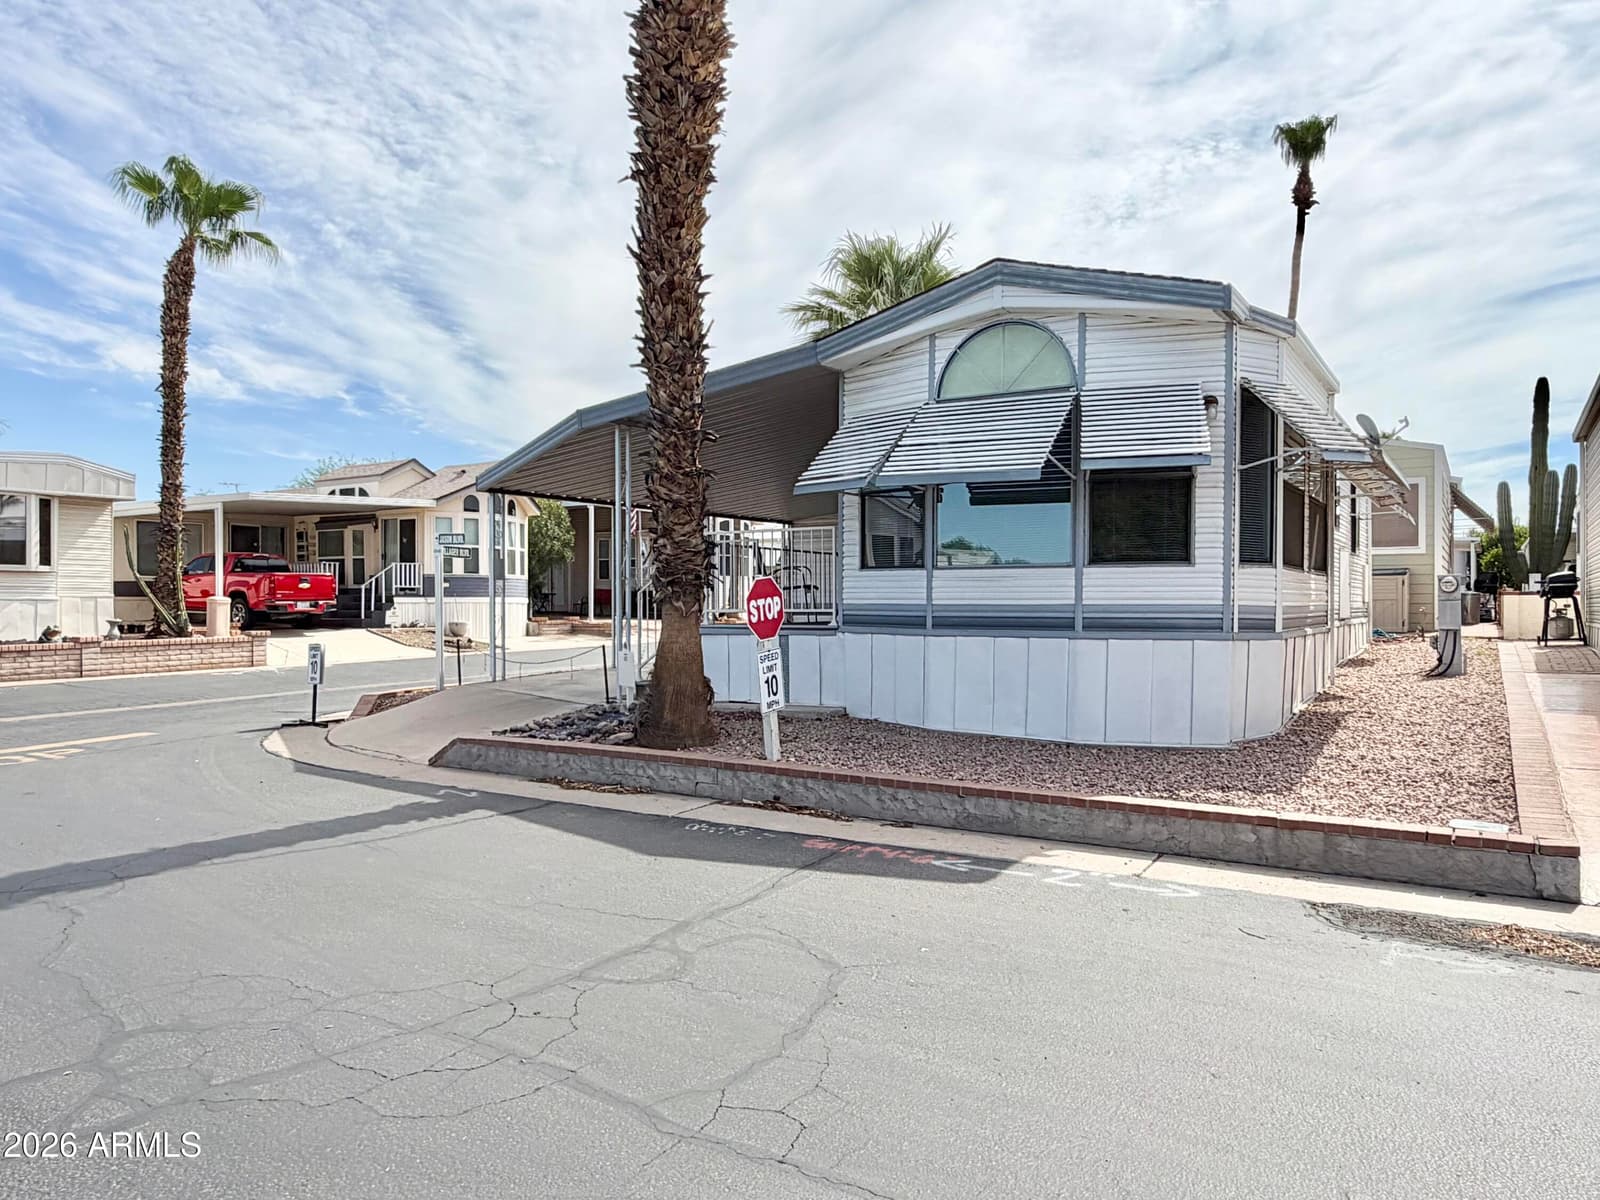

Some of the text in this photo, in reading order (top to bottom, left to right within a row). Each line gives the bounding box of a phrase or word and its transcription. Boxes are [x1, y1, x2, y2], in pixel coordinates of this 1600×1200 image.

[749, 595, 781, 624] STOP
[759, 651, 779, 664] SPEED
[310, 660, 318, 675] 10
[762, 663, 778, 675] LIMIT
[764, 674, 779, 698] 10
[766, 698, 780, 710] MPH
